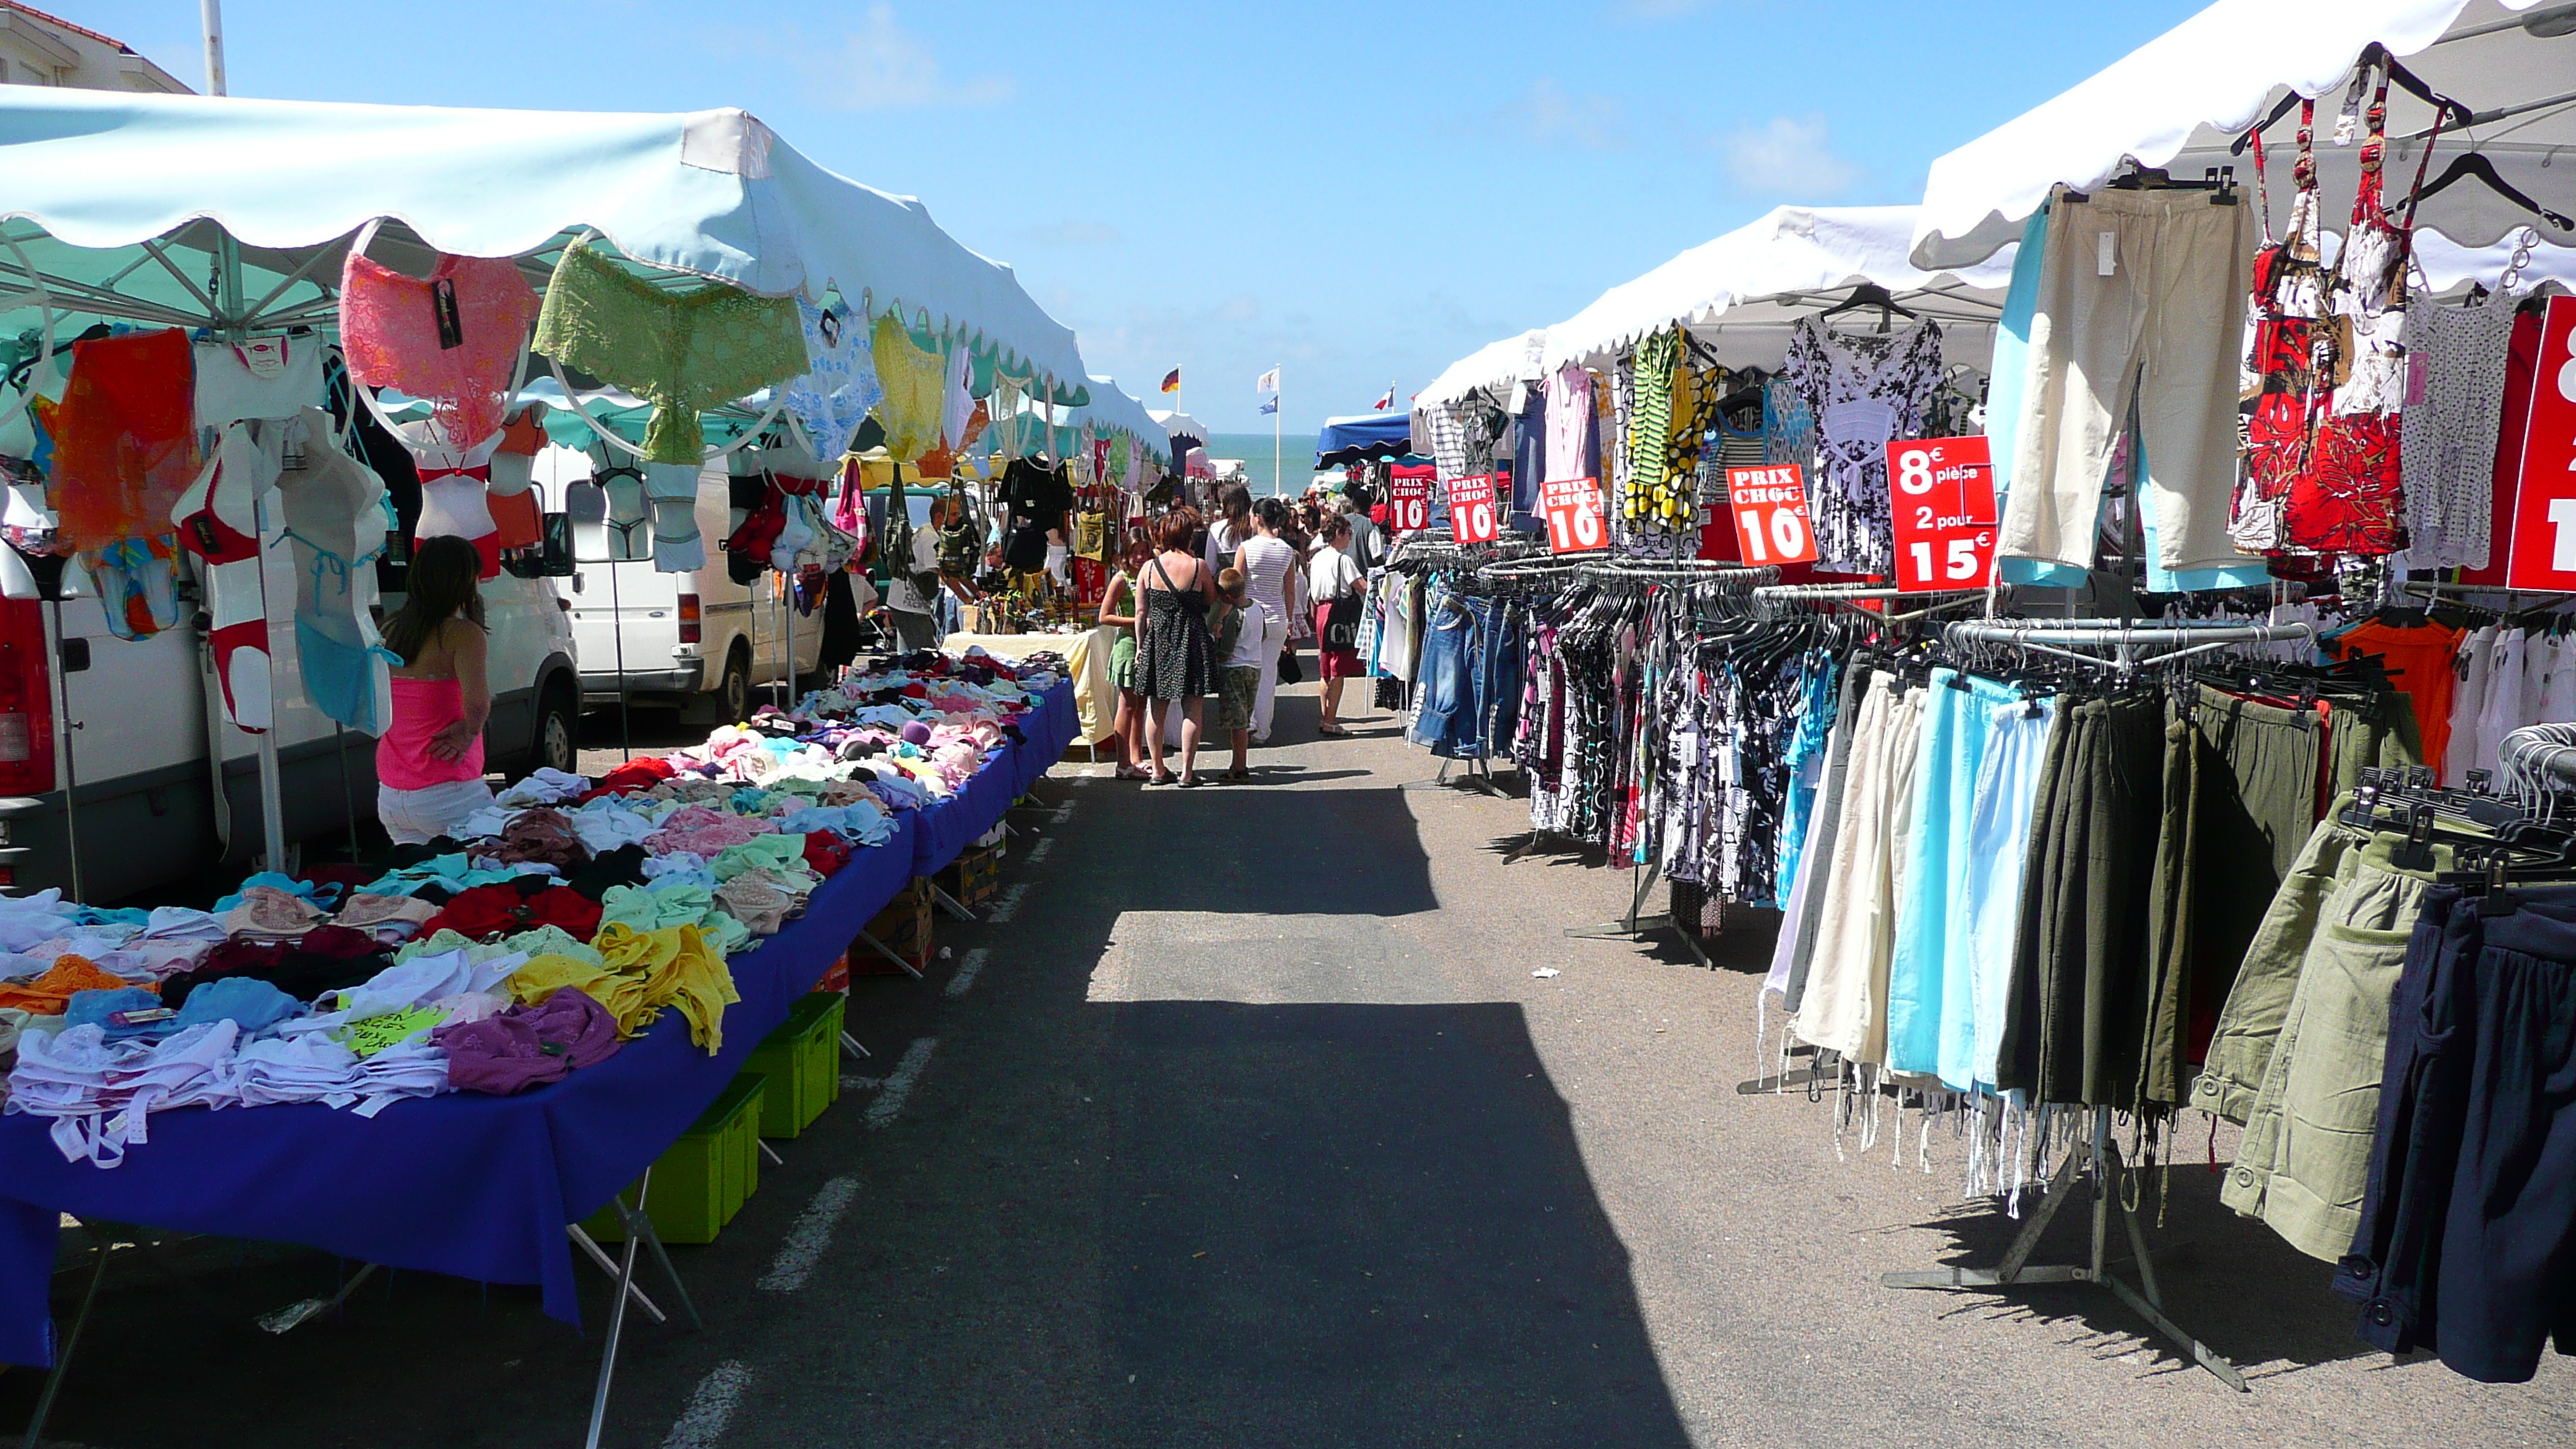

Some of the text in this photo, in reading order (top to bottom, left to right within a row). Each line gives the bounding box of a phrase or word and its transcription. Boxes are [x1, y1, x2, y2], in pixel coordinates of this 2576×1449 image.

[1394, 478, 1423, 487] PRIX
[1733, 468, 1794, 487] PRIX
[1936, 466, 1978, 484] pièce
[1392, 488, 1425, 496] CHOC
[1451, 478, 1488, 491] PRIX
[1546, 480, 1592, 495] PRIX
[1451, 489, 1490, 502] CHOC
[1547, 491, 1596, 507] CHOC
[1734, 486, 1800, 504] CHOC
[1916, 506, 1973, 530] 2 pour
